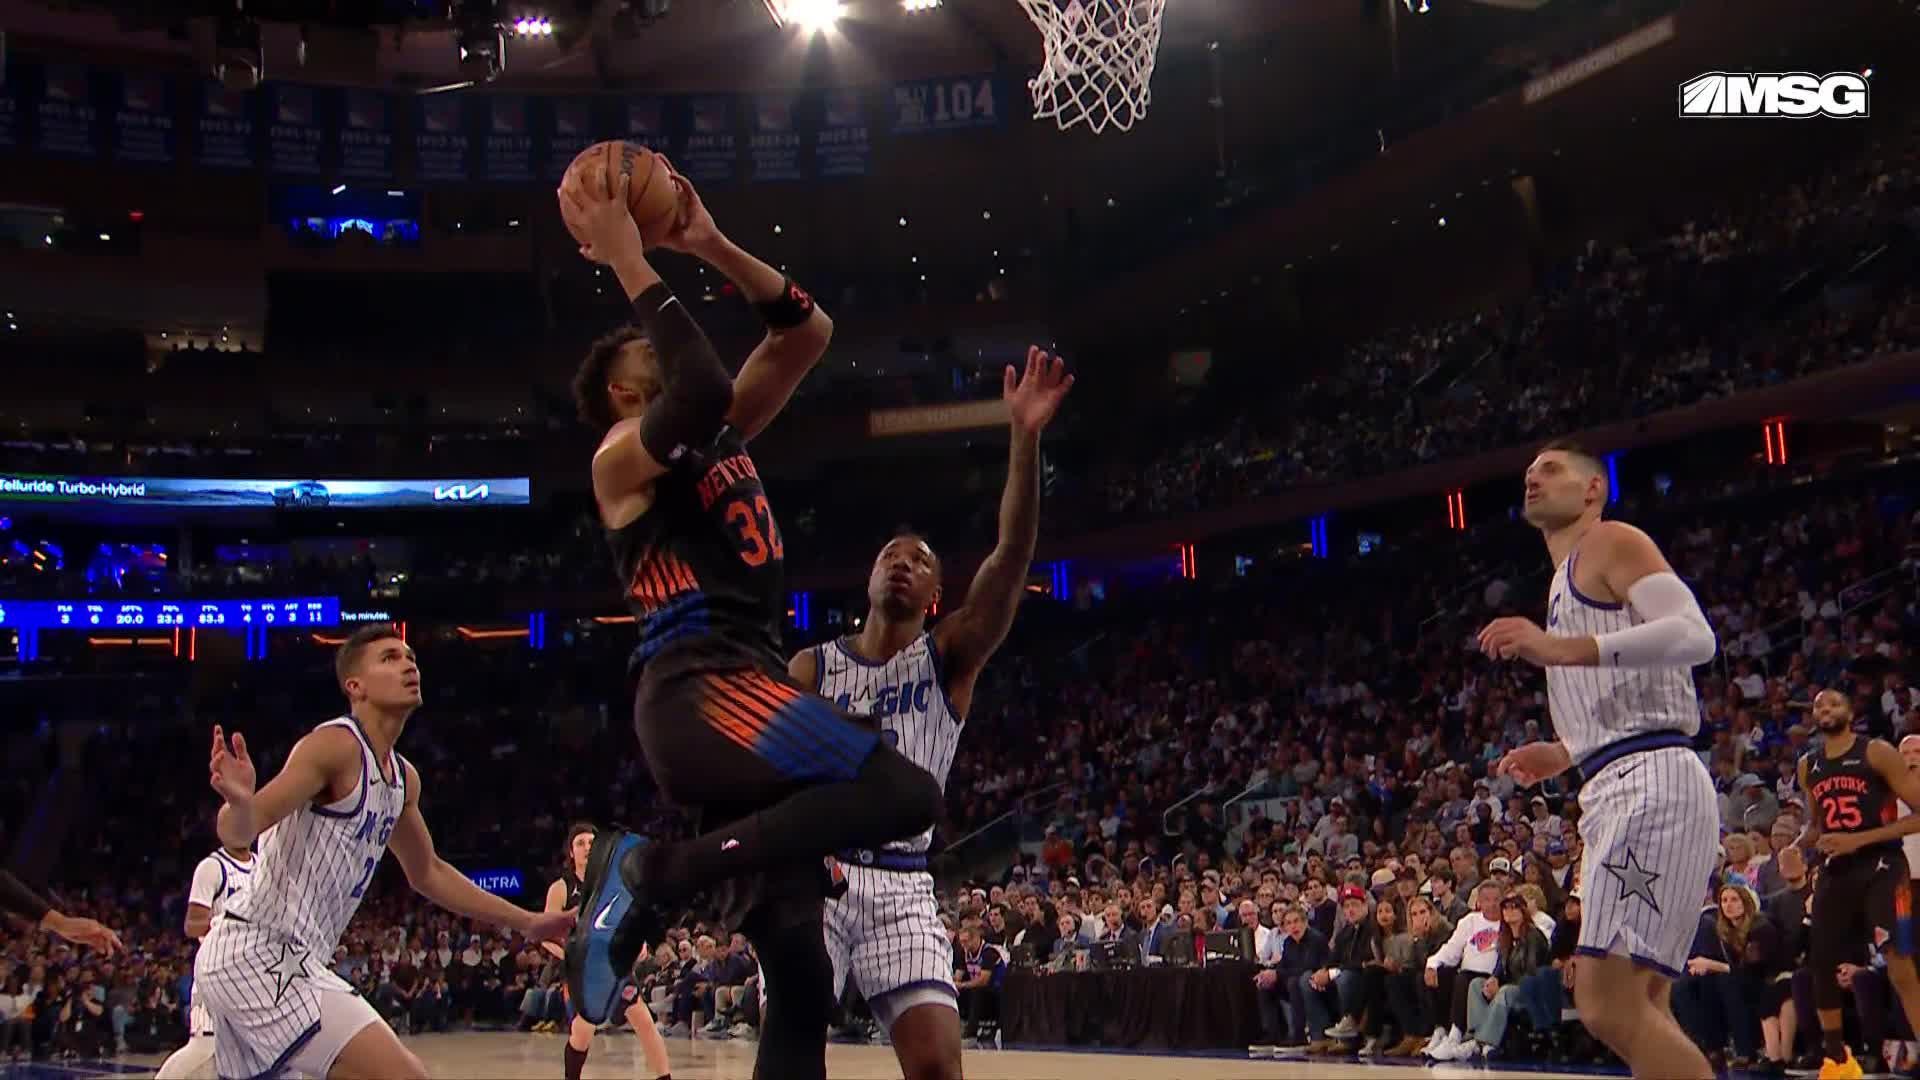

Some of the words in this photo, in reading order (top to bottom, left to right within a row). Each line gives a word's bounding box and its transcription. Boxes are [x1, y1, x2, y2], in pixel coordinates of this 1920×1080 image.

[0, 478, 55, 493] Telluride
[57, 480, 146, 498] Turbo-Hybrid
[727, 495, 784, 568] 32
[116, 613, 144, 624] 20.0
[243, 612, 252, 624] 4
[265, 612, 275, 623] 0
[308, 612, 322, 623] 11
[340, 611, 356, 621] Two
[1823, 796, 1863, 829] 25
